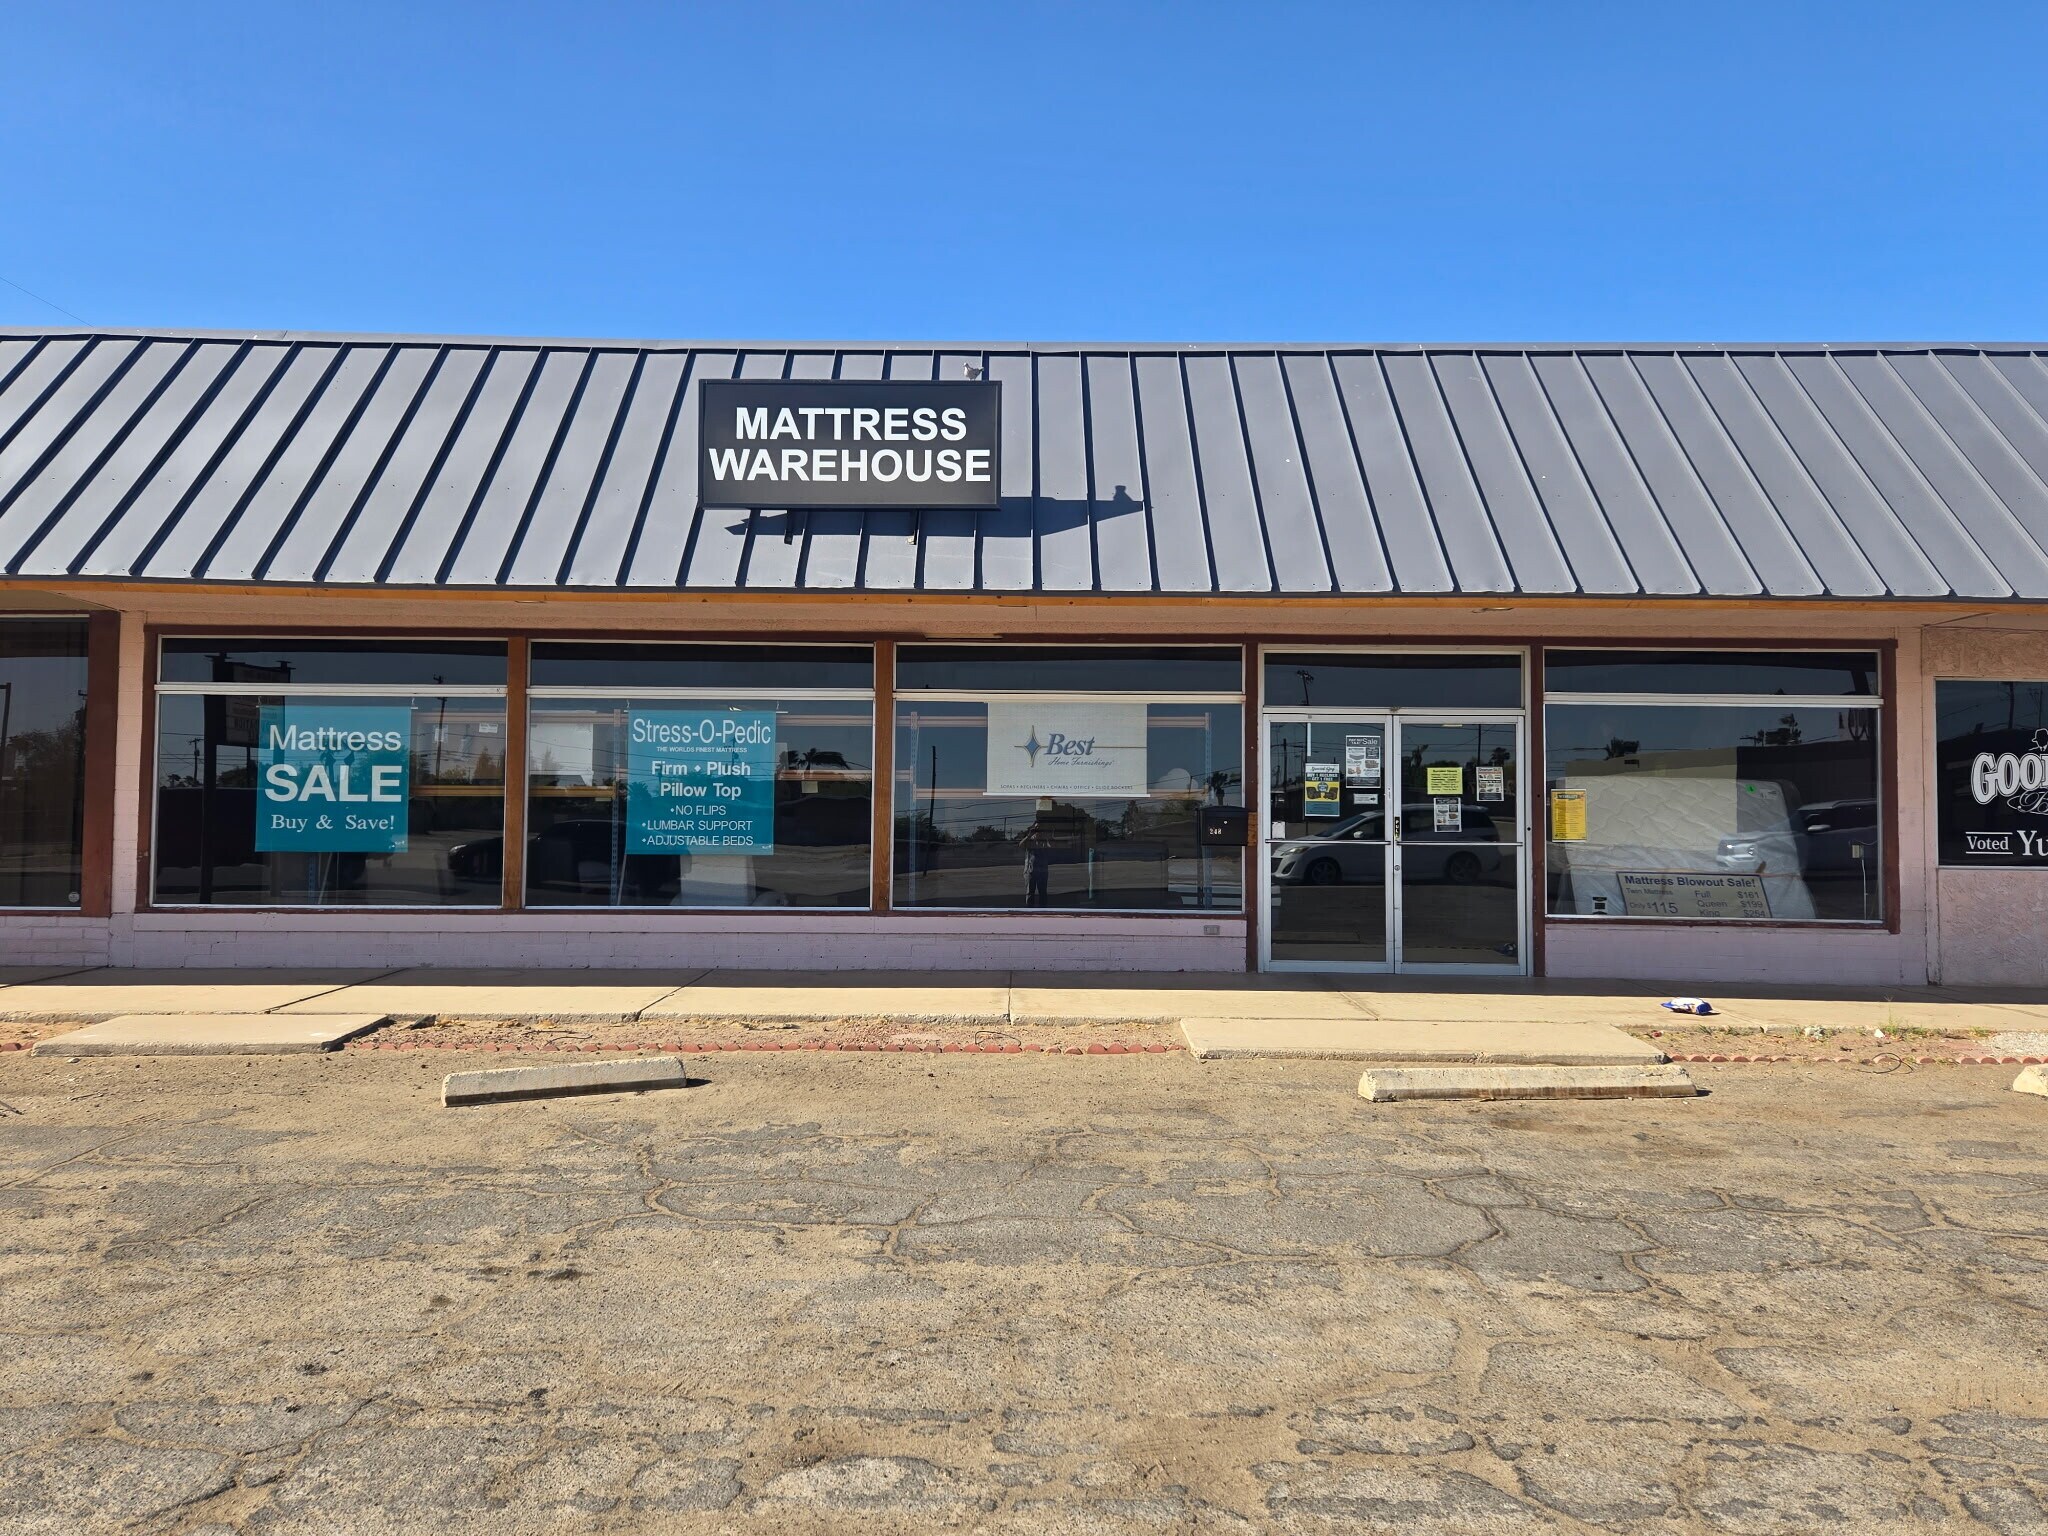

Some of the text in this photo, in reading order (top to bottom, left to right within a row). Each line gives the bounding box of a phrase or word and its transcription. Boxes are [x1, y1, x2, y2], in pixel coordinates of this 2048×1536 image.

[735, 407, 967, 441] MATTRESS
[708, 448, 991, 482] WAREHOUSE
[269, 724, 402, 751] Mattress
[632, 718, 771, 744] Stress-O-Pedic
[1044, 733, 1095, 756] Best
[651, 760, 751, 776] Firm Plush
[1048, 756, 1113, 768] Home Furnishings
[264, 763, 403, 803] SALE
[660, 782, 742, 800] Pillow Top
[675, 805, 727, 816] NO FLIPS
[270, 814, 395, 833] Buy & Save!
[647, 820, 753, 831] LUMBAR SUPPORT
[647, 835, 754, 846] ADJUSTABLE BEDS
[1966, 836, 2009, 851] Voted
[1624, 875, 1756, 888] Mattress Blowout Sale!
[1694, 890, 1711, 898] Full
[1629, 902, 1646, 910] Only
[1697, 900, 1763, 909] Queen $199
[1700, 909, 1721, 918] King
